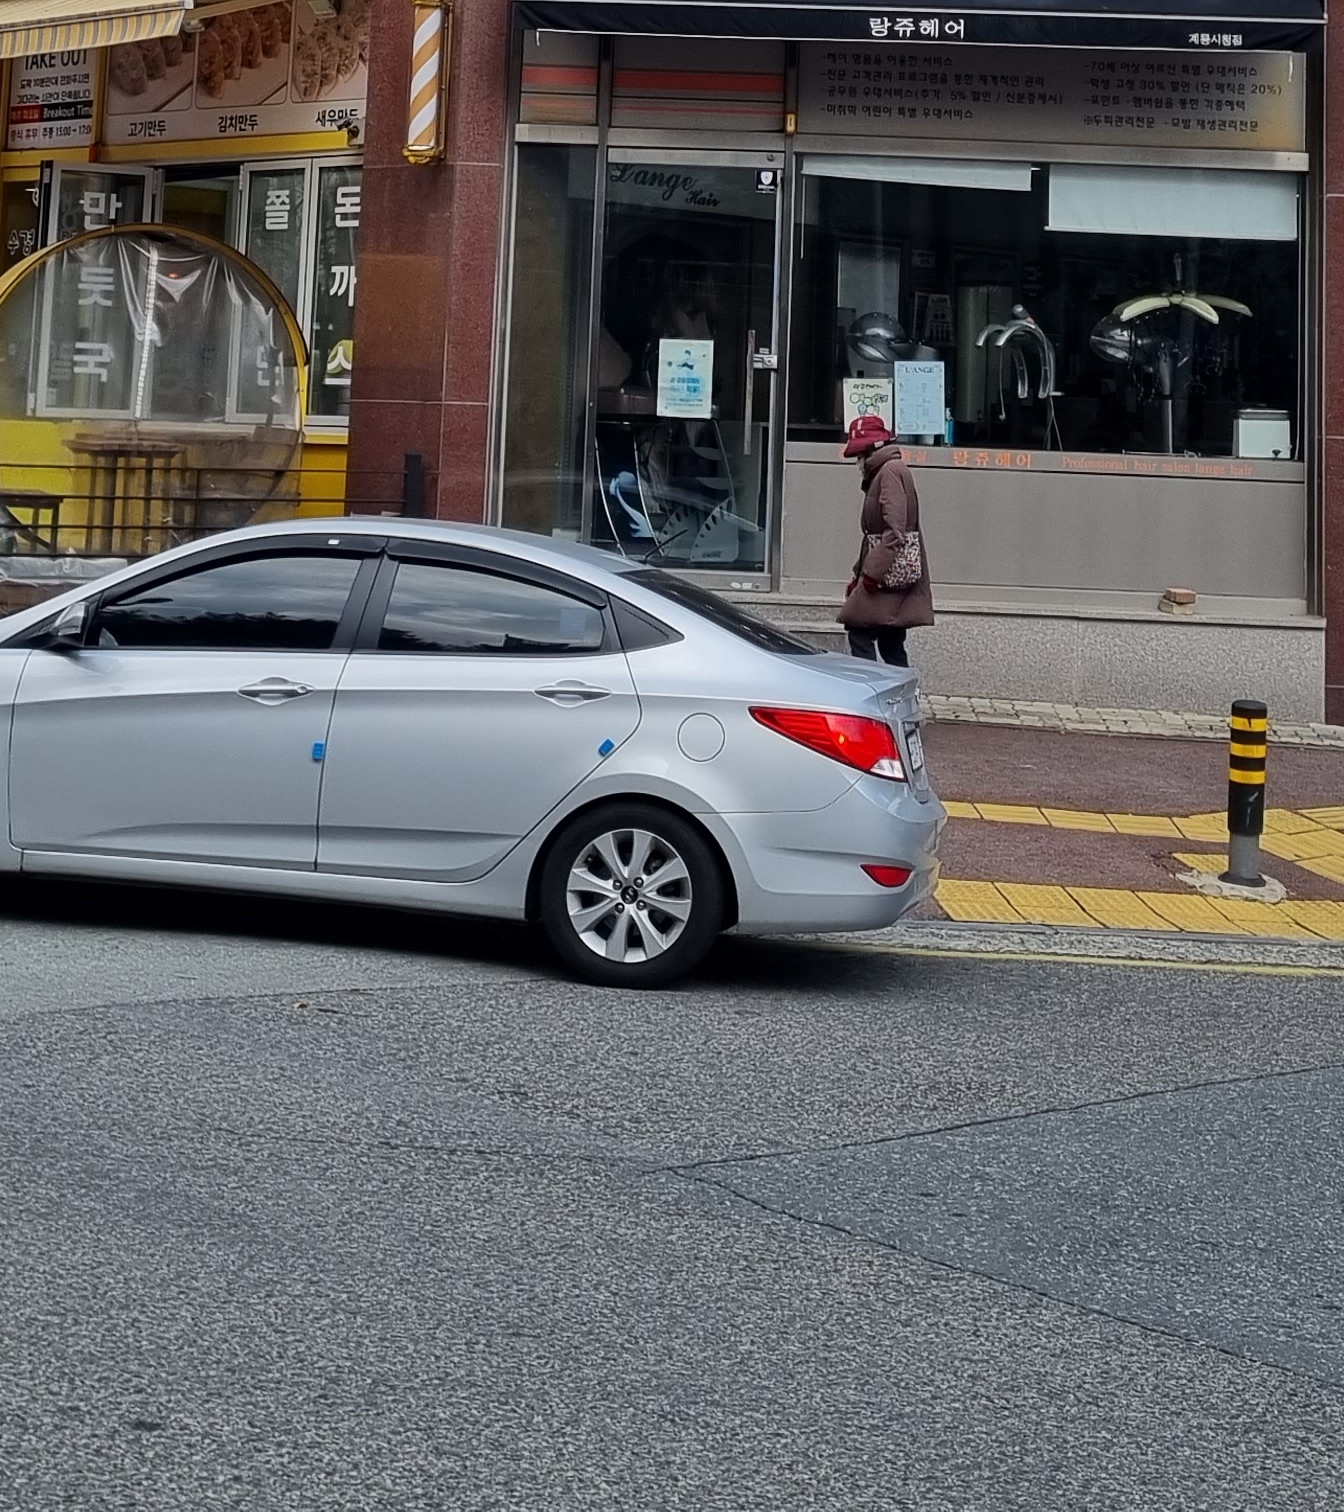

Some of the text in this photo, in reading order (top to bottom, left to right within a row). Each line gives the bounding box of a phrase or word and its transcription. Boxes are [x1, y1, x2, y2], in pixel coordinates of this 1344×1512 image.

[868, 15, 967, 40] 랑쥬헤어
[127, 119, 167, 139] 고기만두
[217, 114, 259, 134] 김치만두
[685, 189, 721, 207] Hair
[953, 452, 1032, 469] 랑쥬헤어
[1061, 455, 1128, 471] Professional
[1134, 457, 1156, 472] hair
